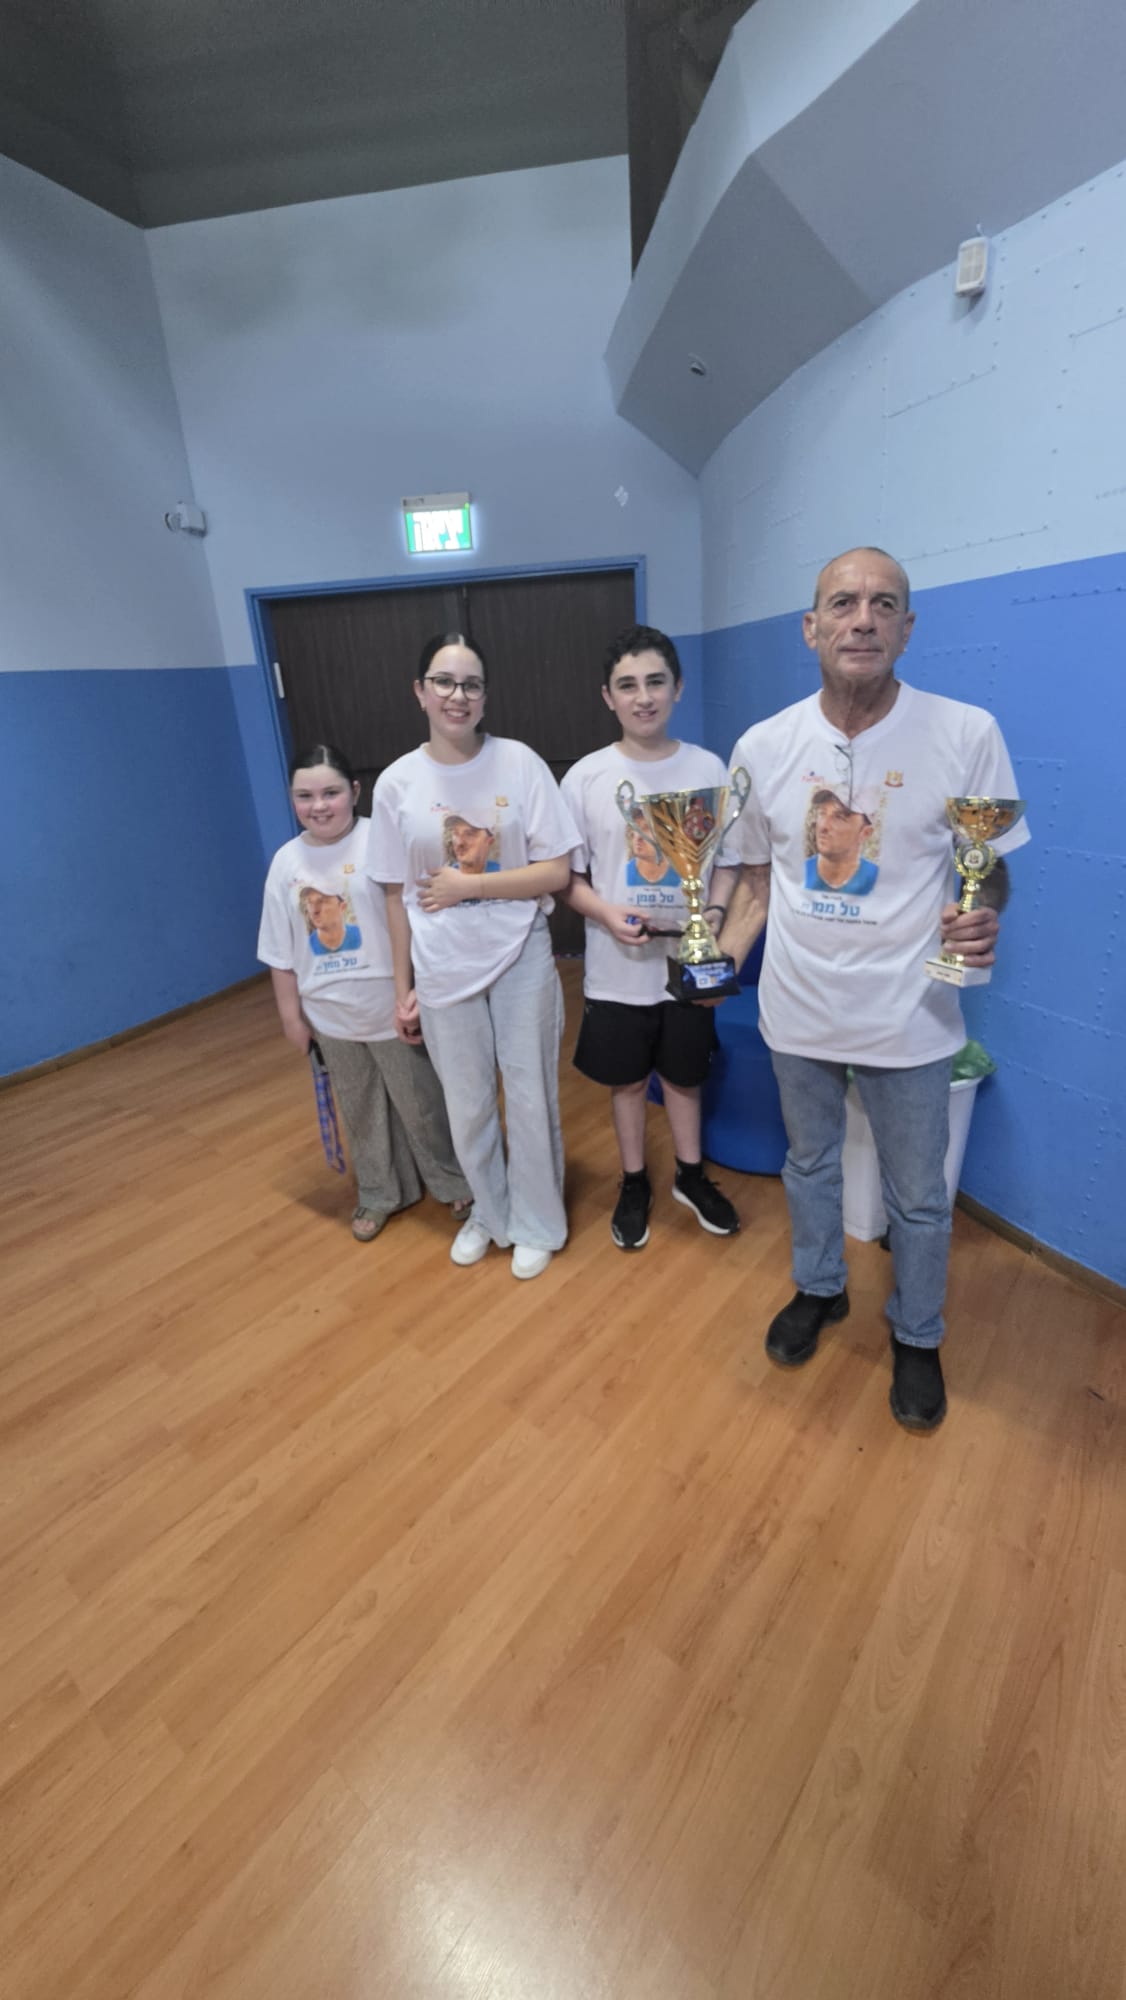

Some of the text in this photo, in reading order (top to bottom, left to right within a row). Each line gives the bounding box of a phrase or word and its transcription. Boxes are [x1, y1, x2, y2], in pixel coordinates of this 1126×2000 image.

[660, 892, 674, 903] טל
[812, 901, 835, 914] ממן
[840, 901, 860, 916] טל
[342, 957, 357, 967] טל
